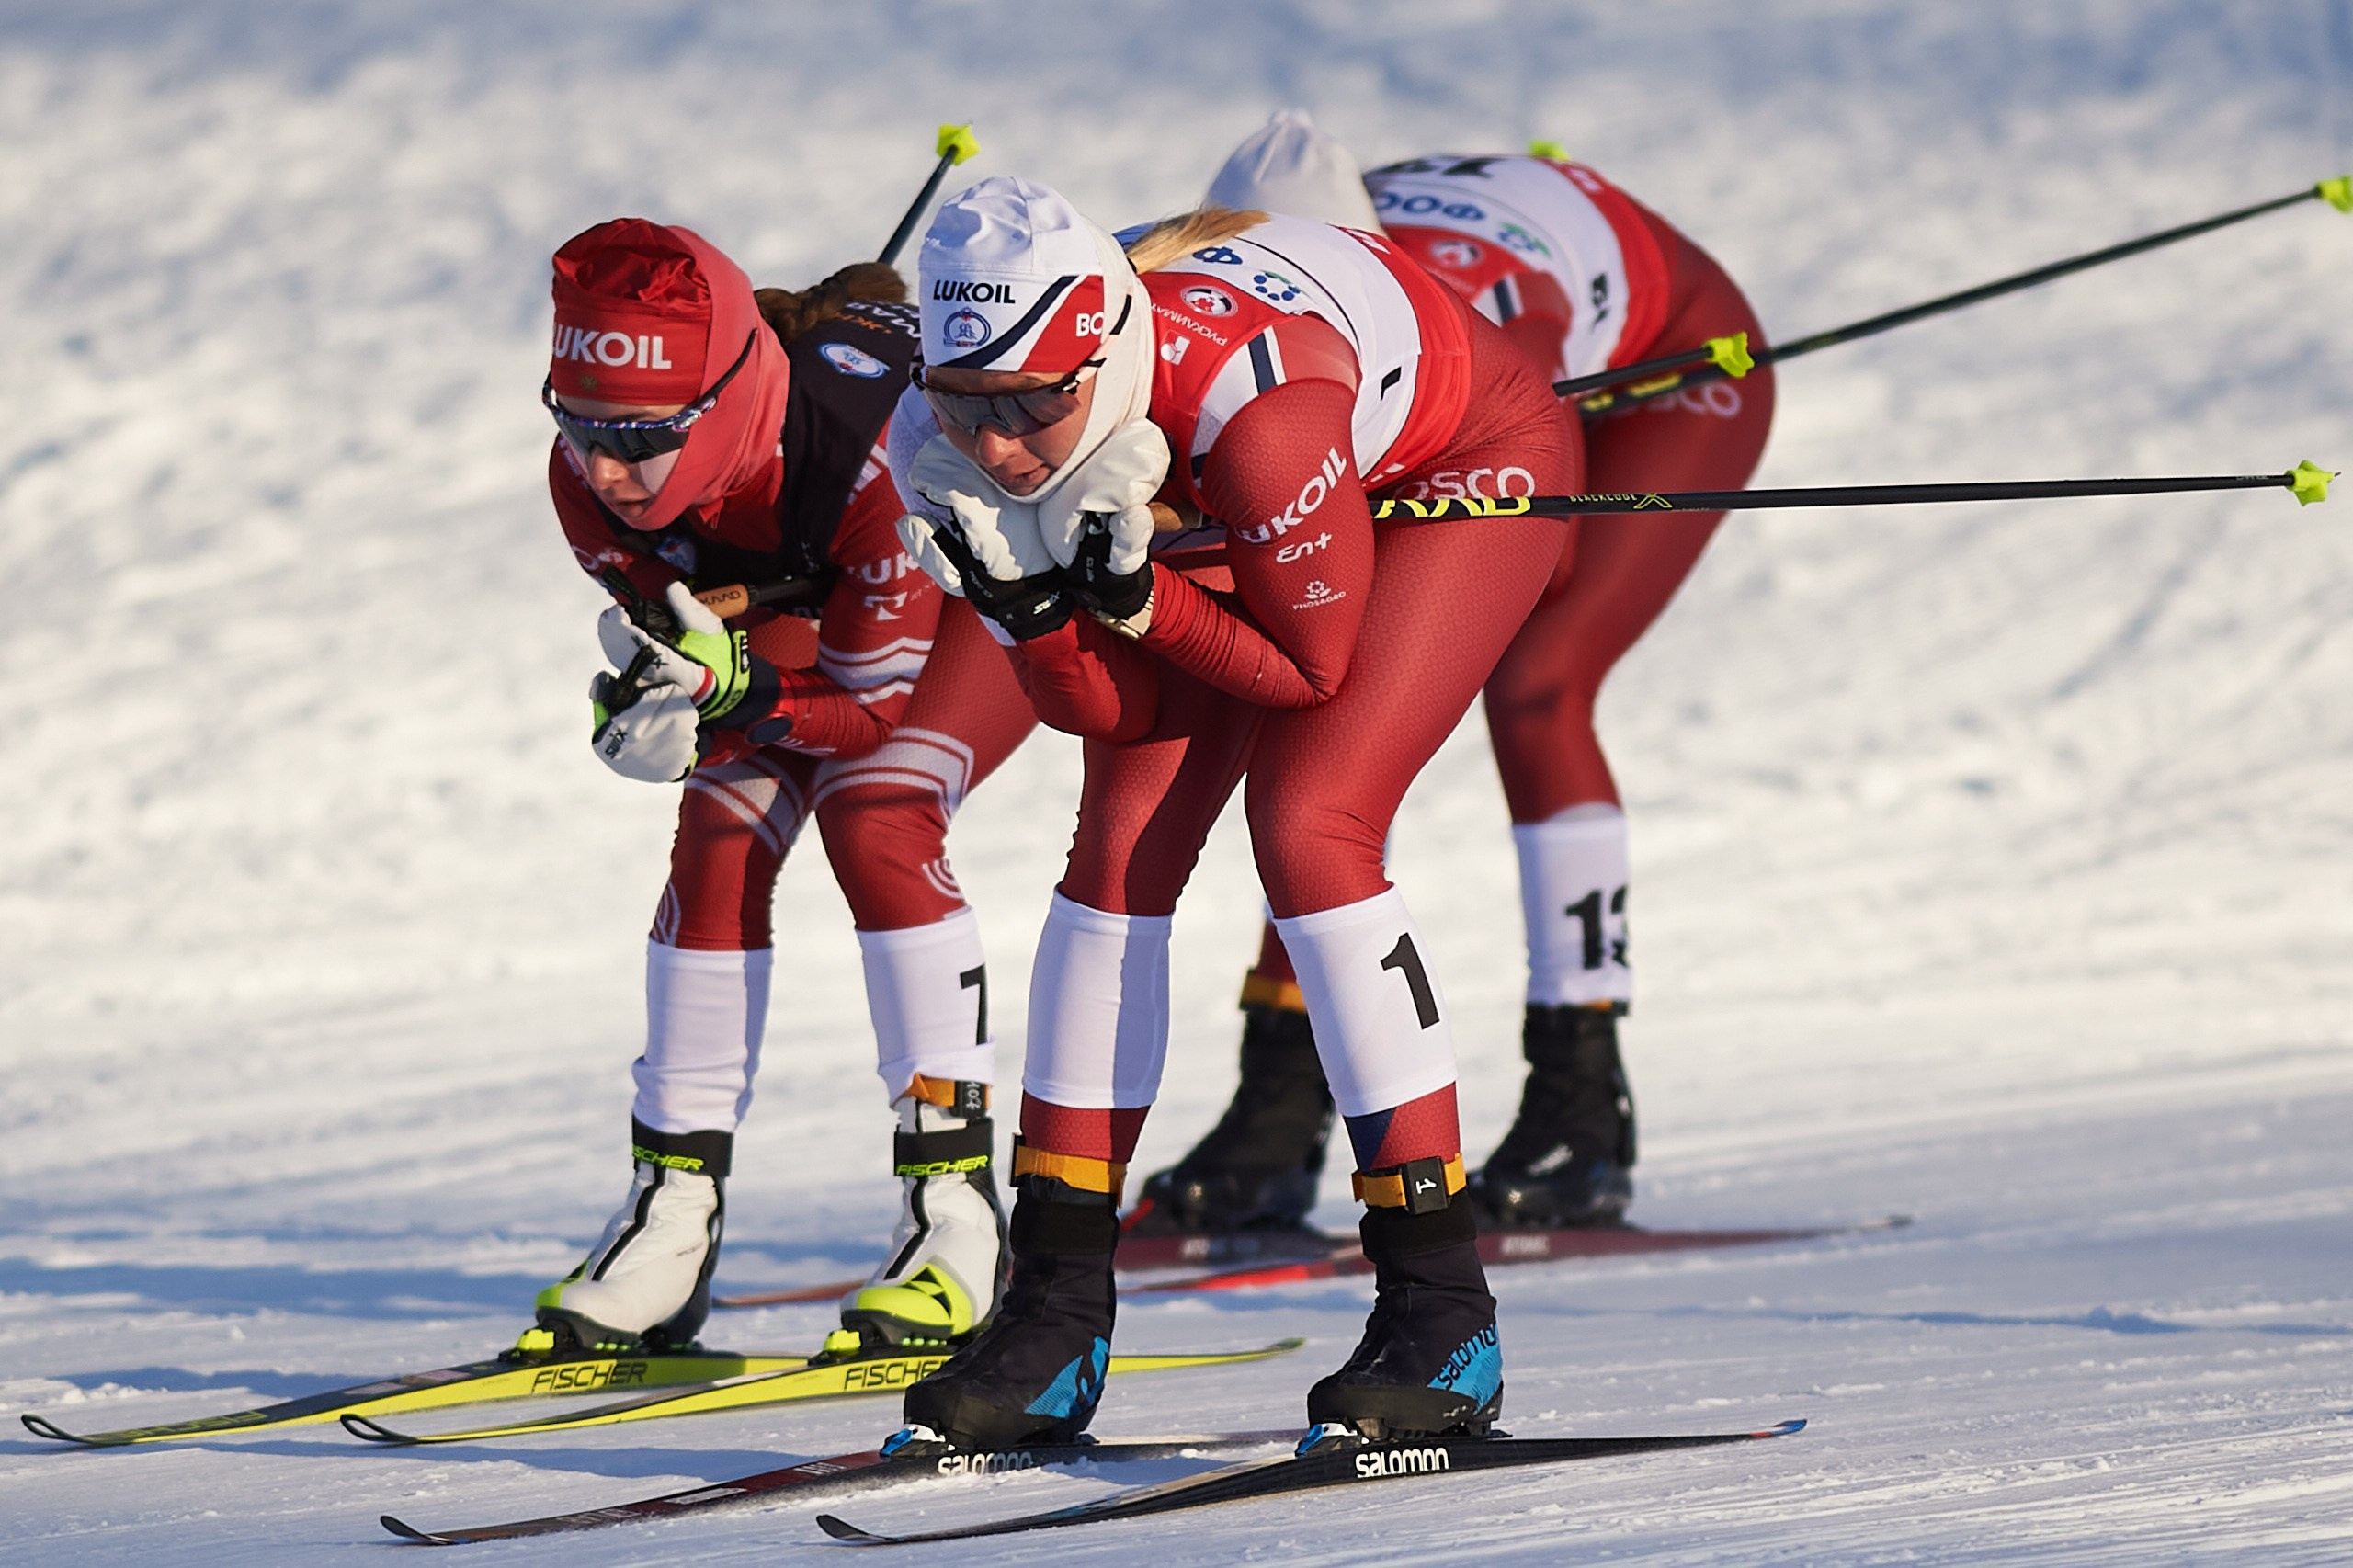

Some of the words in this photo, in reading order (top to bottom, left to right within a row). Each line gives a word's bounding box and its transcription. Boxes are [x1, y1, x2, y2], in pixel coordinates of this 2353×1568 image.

[933, 279, 1016, 304] LUKOIL
[552, 324, 672, 369] UKOIL
[1240, 446, 1347, 544] UKOIL
[1380, 932, 1440, 1030] 1
[897, 1154, 989, 1176] FISCHER
[531, 1362, 648, 1394] FISCHER
[844, 1360, 947, 1390] FISCHE
